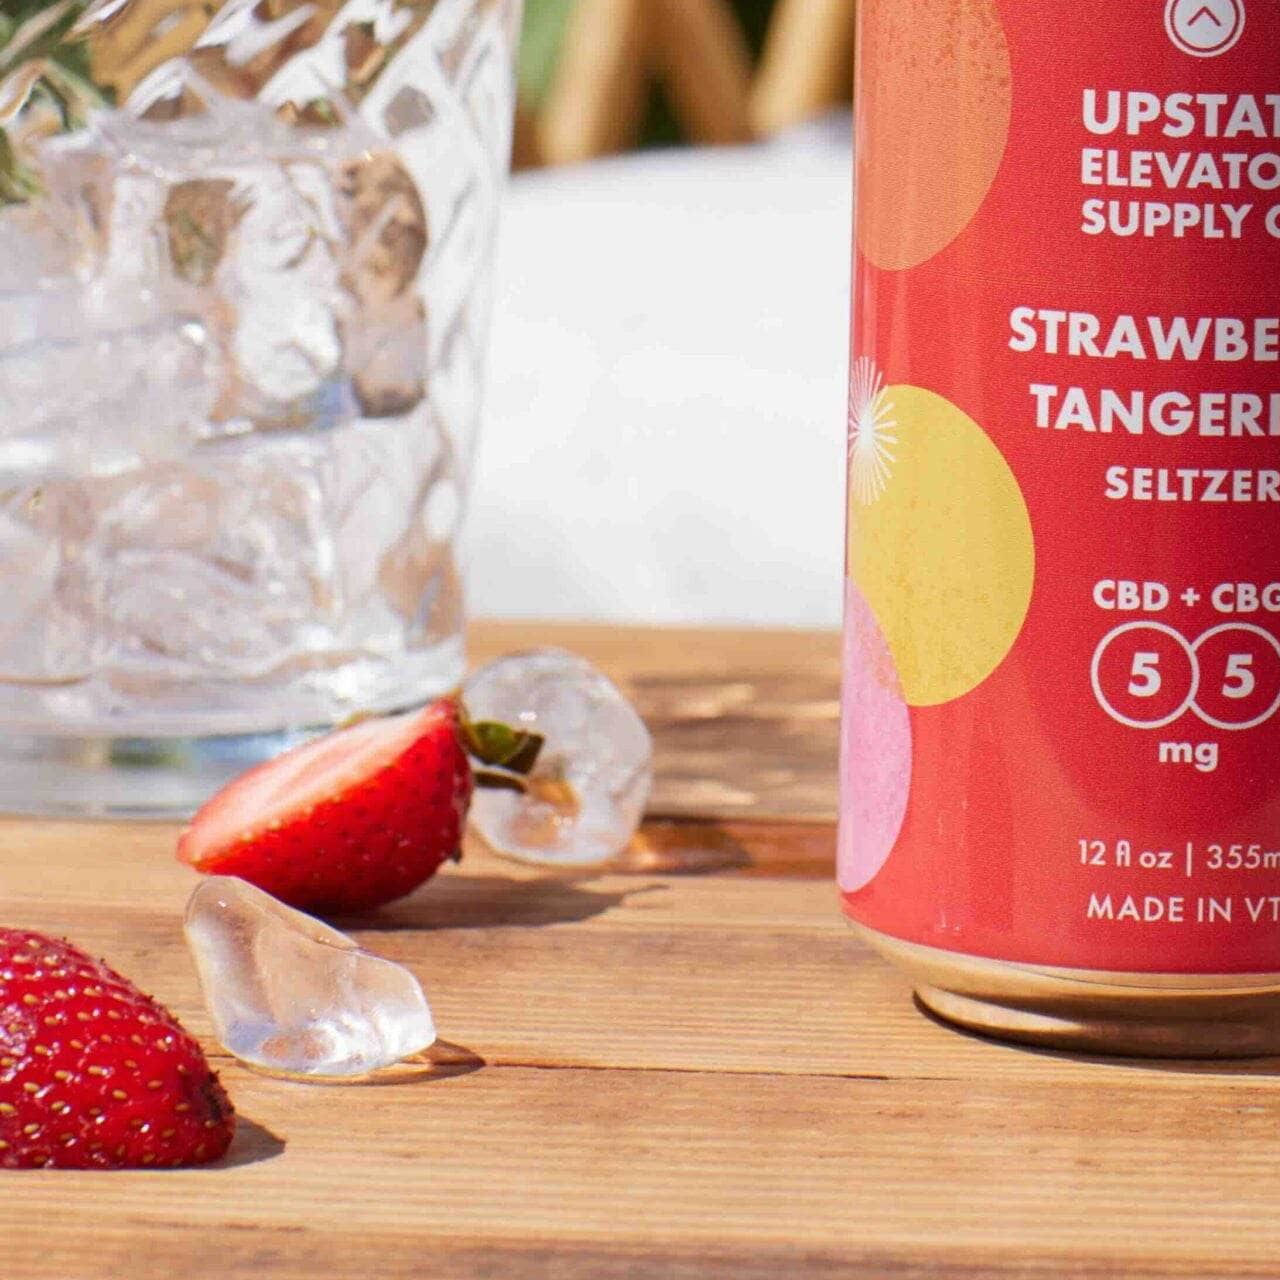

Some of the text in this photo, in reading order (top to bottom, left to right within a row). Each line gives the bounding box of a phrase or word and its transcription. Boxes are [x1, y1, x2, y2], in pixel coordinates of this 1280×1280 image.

[1081, 199, 1253, 239] SUPPLY
[1092, 580, 1170, 612] CBD
[1128, 653, 1255, 699] 5 5
[1158, 742, 1219, 773] mg
[1078, 839, 1106, 866] 12
[1115, 839, 1131, 867] fl
[1139, 851, 1174, 869] oz
[1087, 893, 1184, 923] MADE
[1197, 897, 1232, 923] IN
